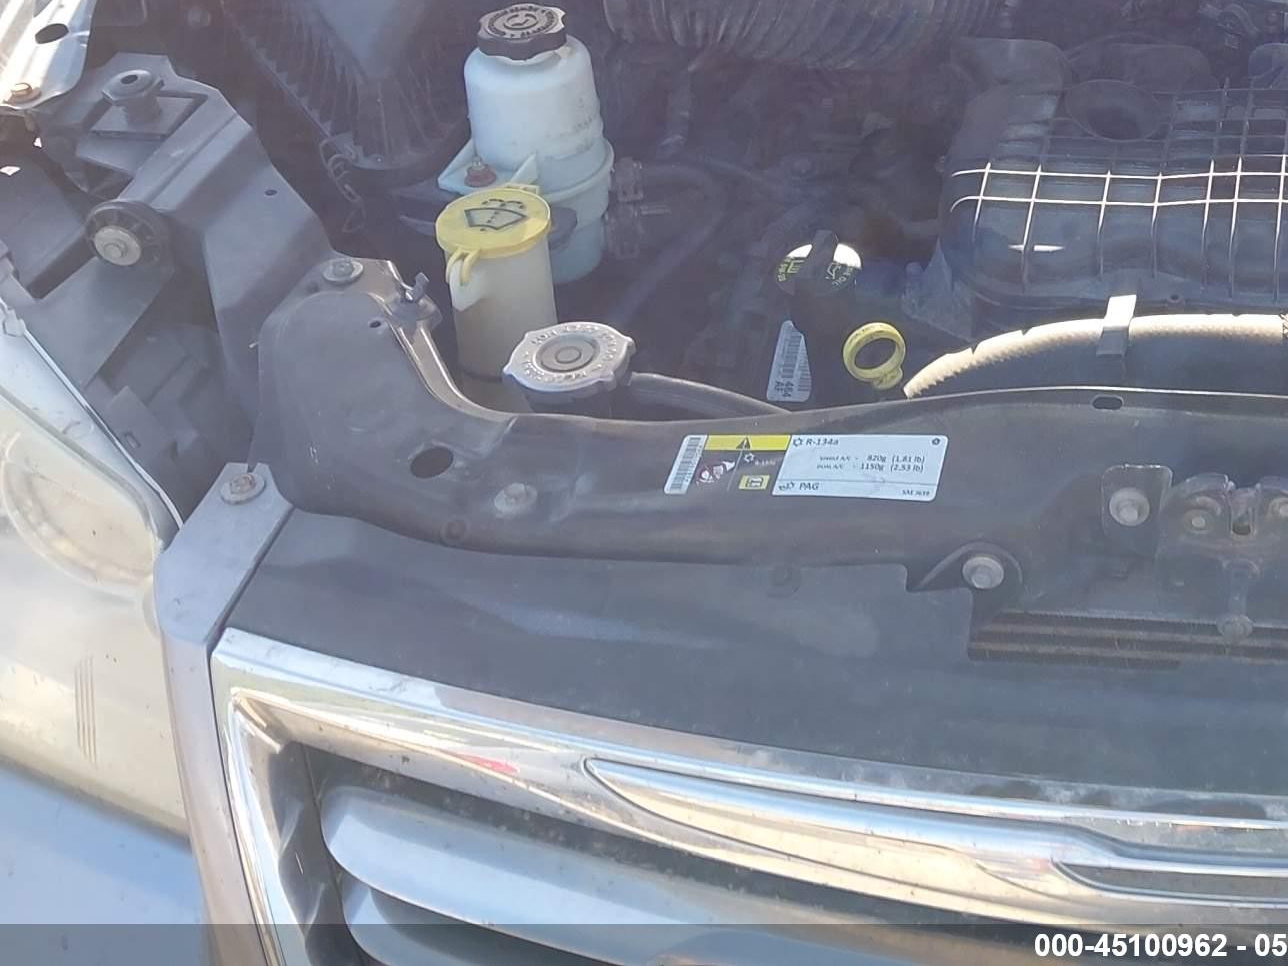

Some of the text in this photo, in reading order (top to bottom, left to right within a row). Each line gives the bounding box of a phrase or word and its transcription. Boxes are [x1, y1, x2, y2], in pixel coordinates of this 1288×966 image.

[805, 437, 839, 446] R-134a
[866, 454, 886, 463] 820g
[861, 462, 885, 471] 1150g
[890, 463, 910, 472] (2.53
[799, 481, 820, 491] PAG
